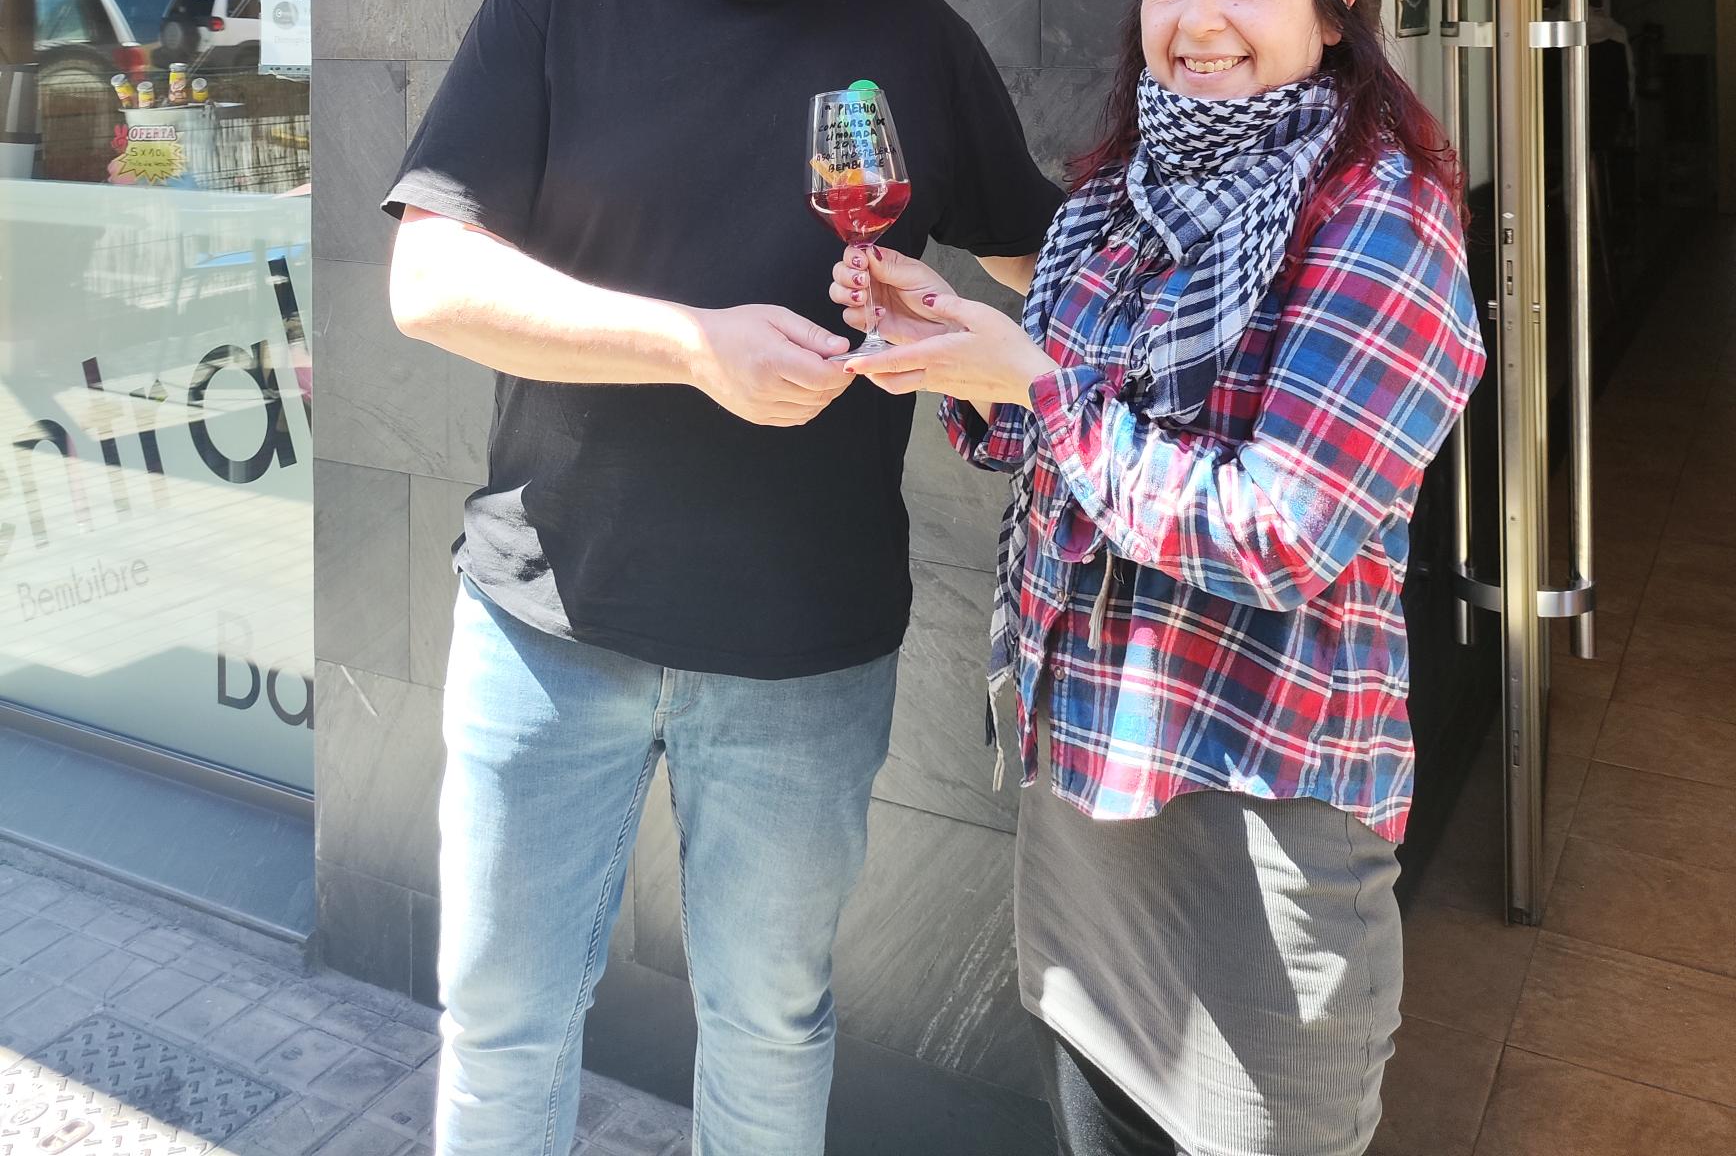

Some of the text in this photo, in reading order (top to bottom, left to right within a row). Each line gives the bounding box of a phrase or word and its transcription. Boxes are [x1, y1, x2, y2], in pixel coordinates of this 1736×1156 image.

[838, 101, 876, 117] PREMIO
[129, 127, 176, 140] OFERTA
[818, 119, 871, 133] CONCURSO
[825, 130, 878, 142] LIMONADA
[828, 158, 884, 173] BEMBIBRE
[0, 255, 312, 560] ntral
[17, 558, 149, 622] Bembibre
